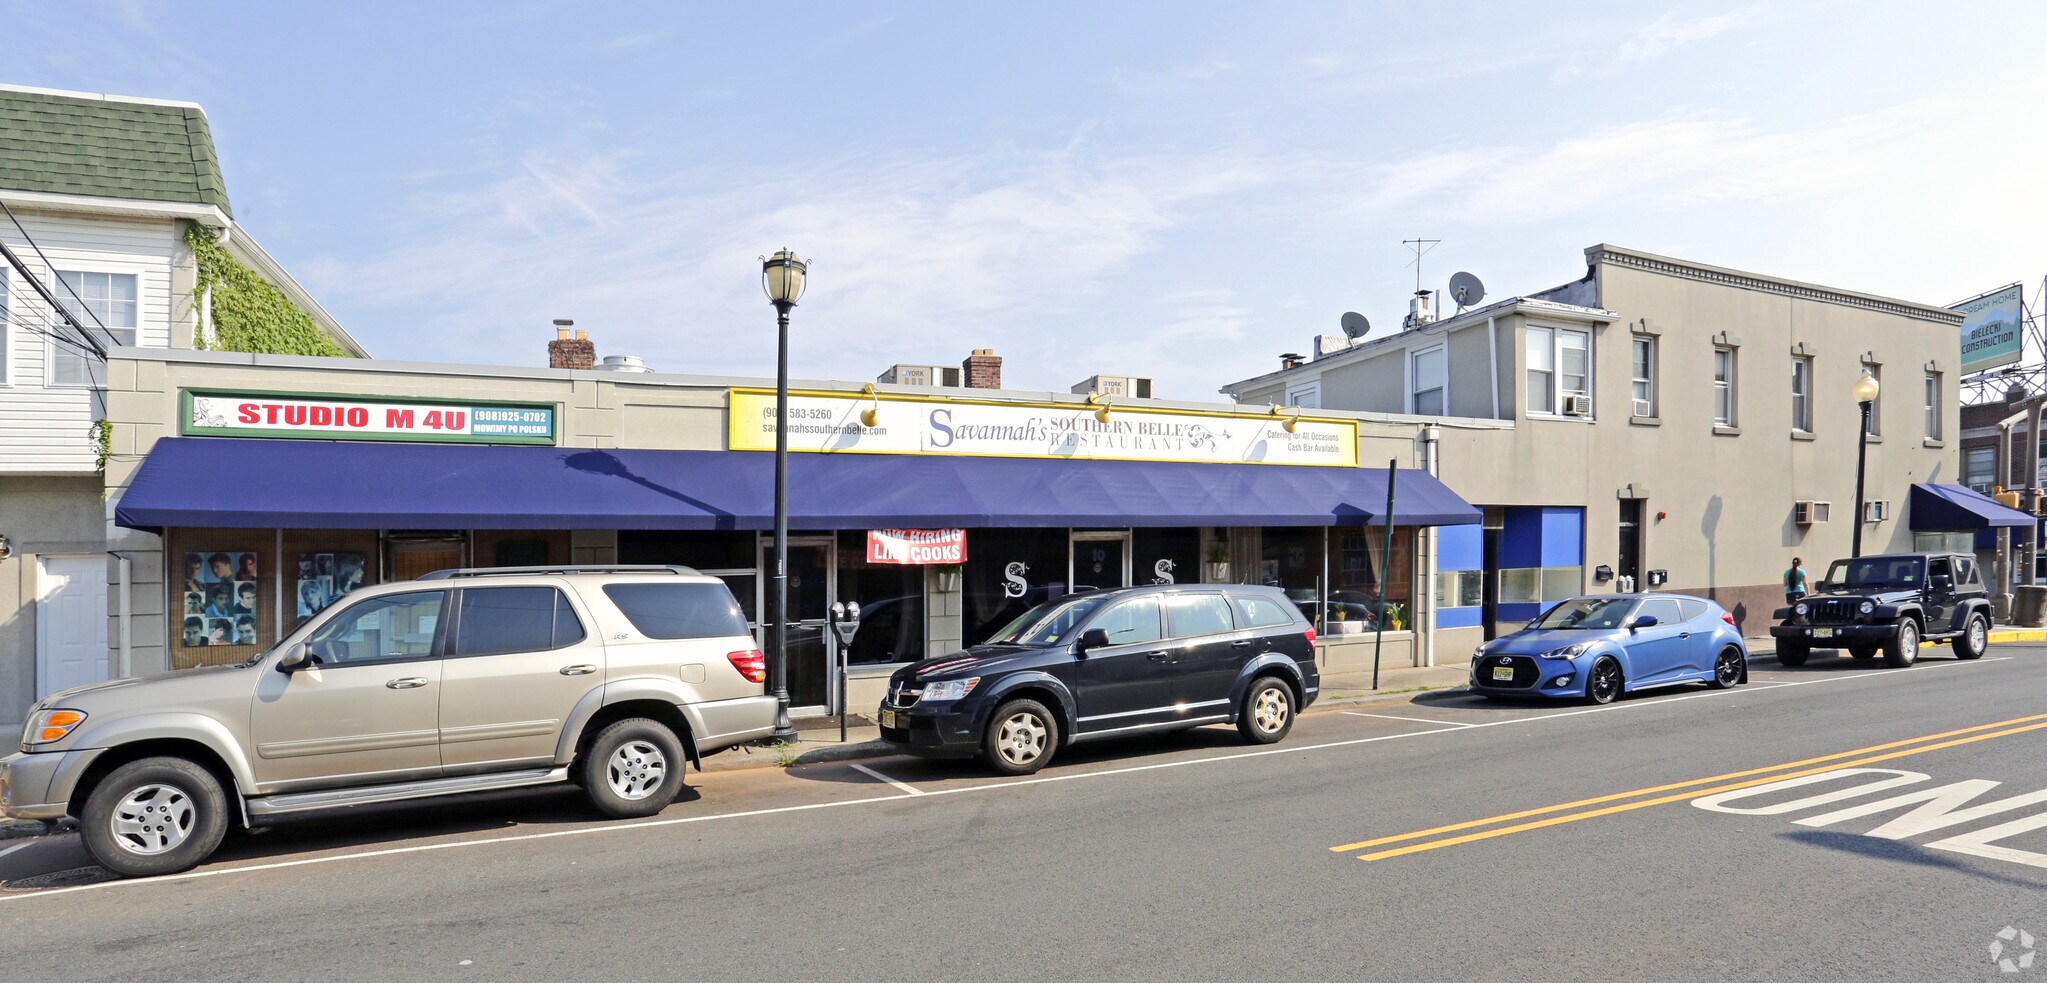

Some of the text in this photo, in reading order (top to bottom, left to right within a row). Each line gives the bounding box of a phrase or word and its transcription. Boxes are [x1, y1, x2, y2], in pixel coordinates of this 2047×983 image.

[1992, 291, 2017, 306] HOME
[1971, 322, 2001, 340] BIELECKI
[1961, 331, 2014, 354] CONSTRUCTION
[238, 403, 465, 430] STUDIO M 4U
[475, 410, 546, 422] (908)925-0702
[789, 408, 832, 419] 583-5260
[473, 423, 547, 434] MOWIMY PO POLSKU
[929, 409, 1048, 447] Savannah's
[1050, 417, 1184, 437] SOUTHERN BELLE
[1050, 433, 1184, 451] RESTAURANT
[1267, 430, 1292, 441] Catering
[1288, 443, 1339, 453] Cash Bar Available
[910, 528, 961, 544] HIRING
[911, 545, 960, 561] COOKS
